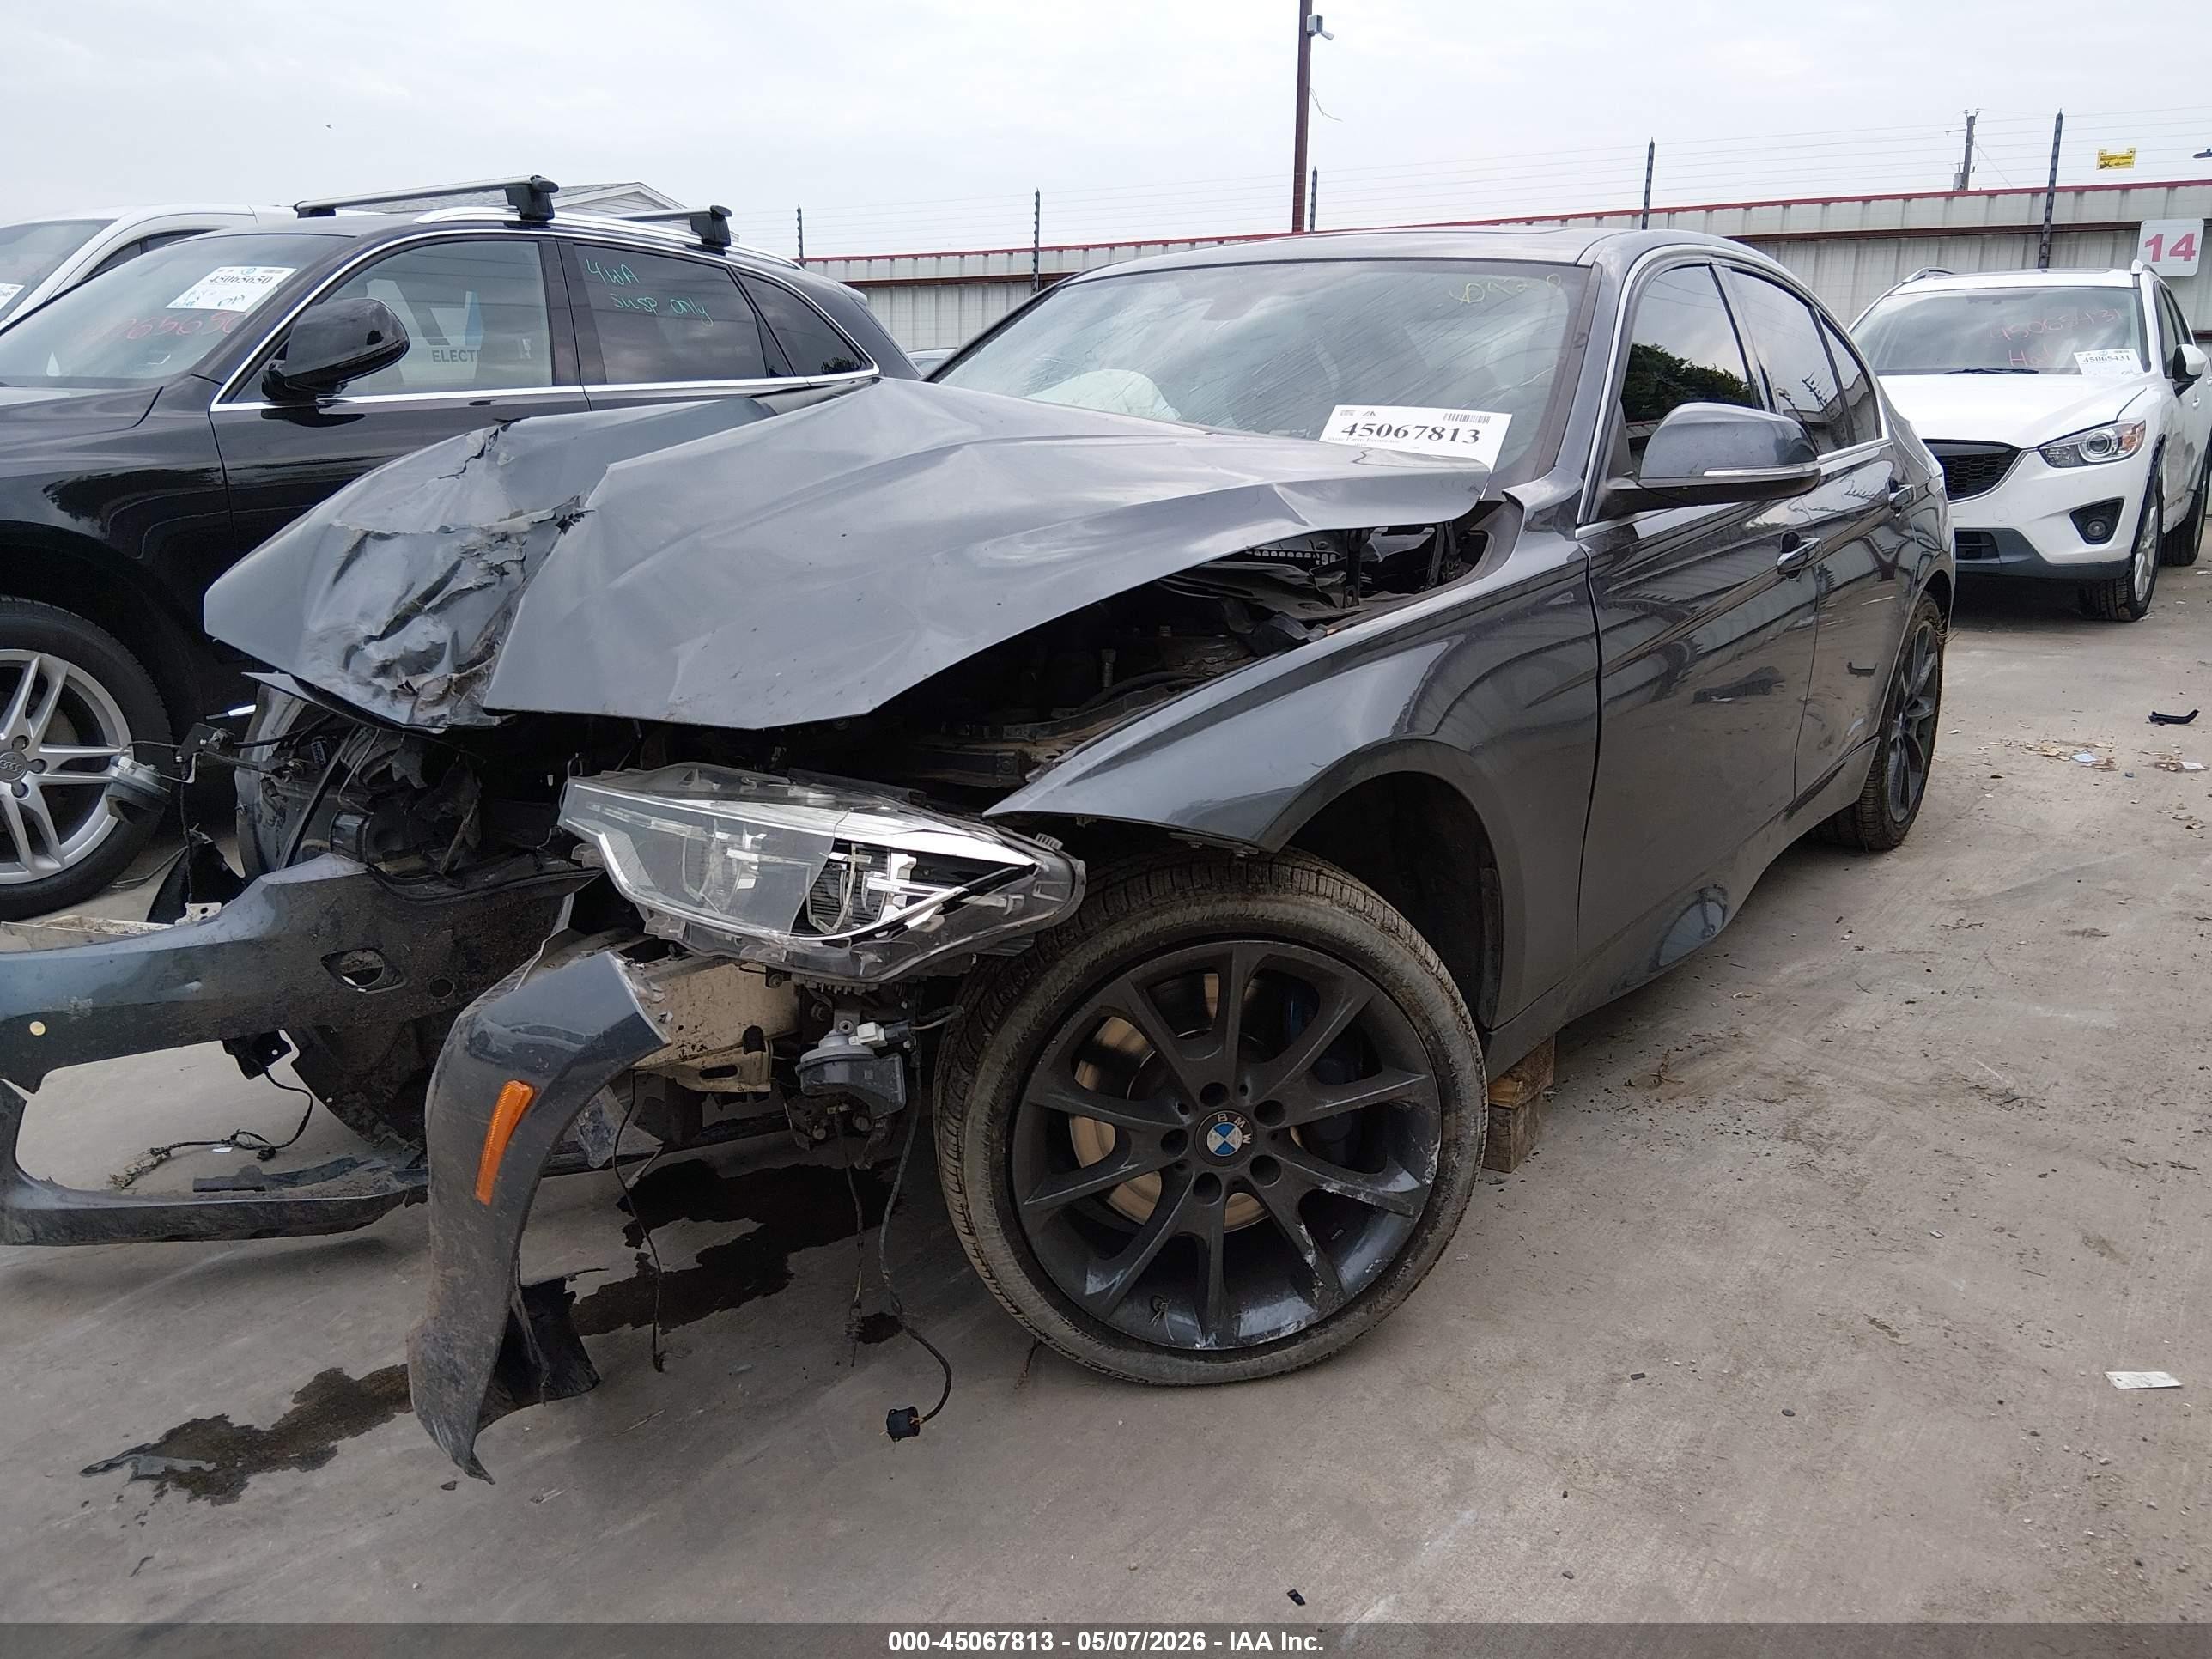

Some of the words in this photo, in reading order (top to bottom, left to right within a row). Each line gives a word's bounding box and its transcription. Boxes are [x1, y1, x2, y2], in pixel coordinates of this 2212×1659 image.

[2144, 234, 2196, 262] 14
[432, 349, 482, 362] ELECT
[1340, 422, 1480, 445] 45067813
[1217, 1112, 1253, 1144] BMW
